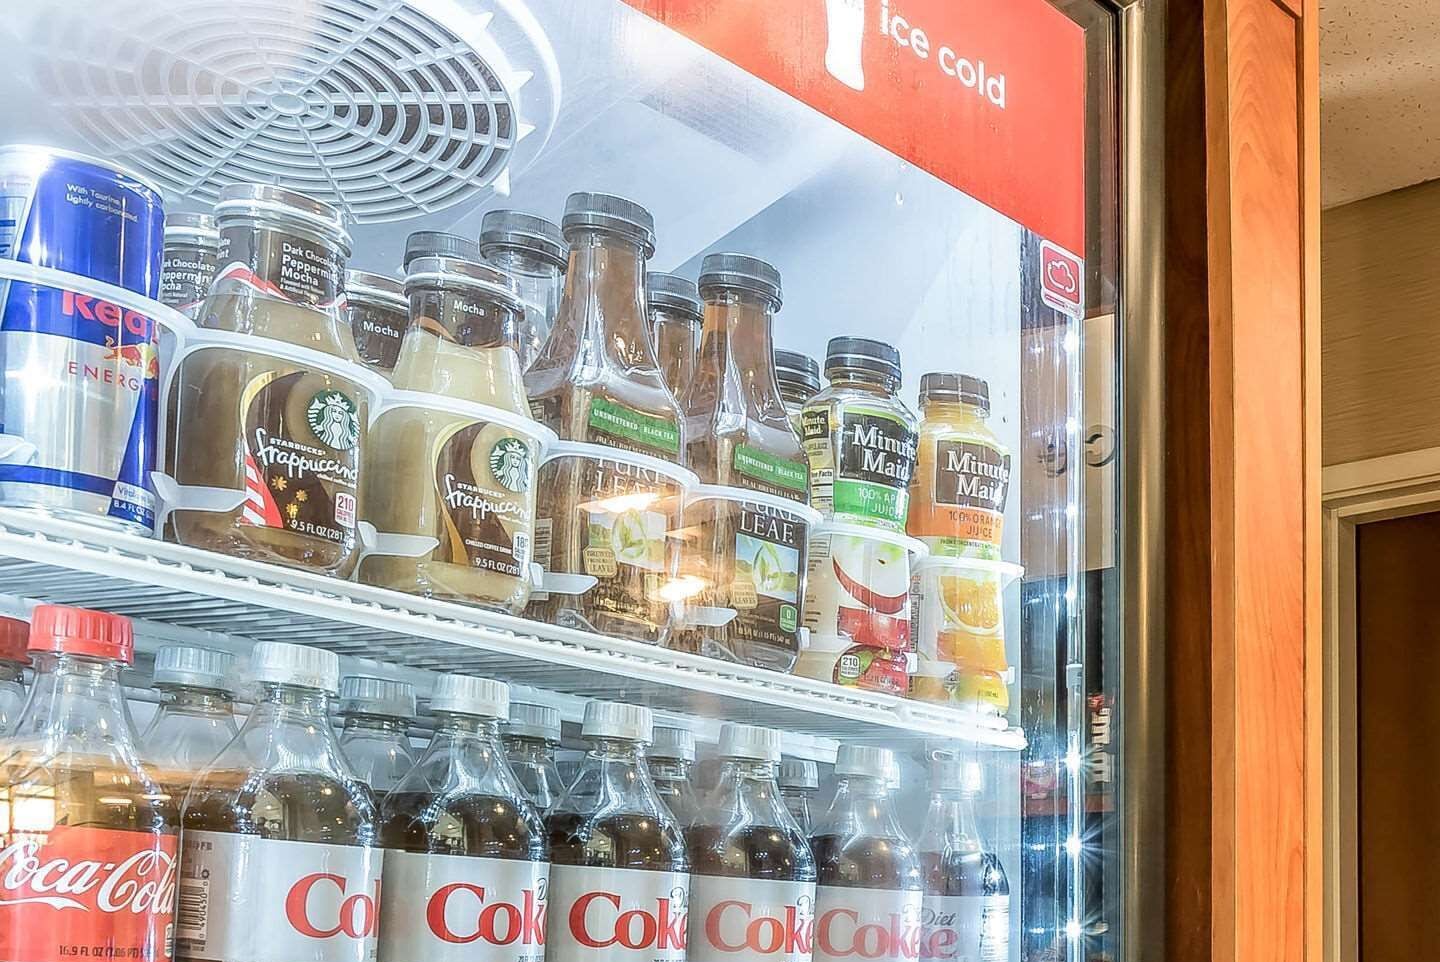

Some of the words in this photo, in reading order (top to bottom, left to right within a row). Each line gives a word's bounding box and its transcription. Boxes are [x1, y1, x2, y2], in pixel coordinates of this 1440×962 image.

[879, 0, 931, 60] ice
[938, 46, 1007, 109] cold
[66, 183, 88, 196] With
[66, 194, 94, 208] Lightly
[282, 242, 303, 257] Dark
[281, 266, 320, 287] Mocha
[453, 299, 486, 317] Mocha
[363, 320, 400, 339] Mocha
[593, 409, 639, 431] UNSWEETENED
[643, 425, 663, 438] BLACK
[663, 431, 675, 442] TEA
[863, 449, 910, 483] Maid
[946, 450, 1009, 483] Minute
[957, 474, 1004, 502] Maid
[338, 495, 354, 512] 210
[740, 510, 794, 544] LEAF
[842, 656, 858, 667] 210
[426, 882, 547, 946] Cok
[921, 907, 956, 927] Diet
